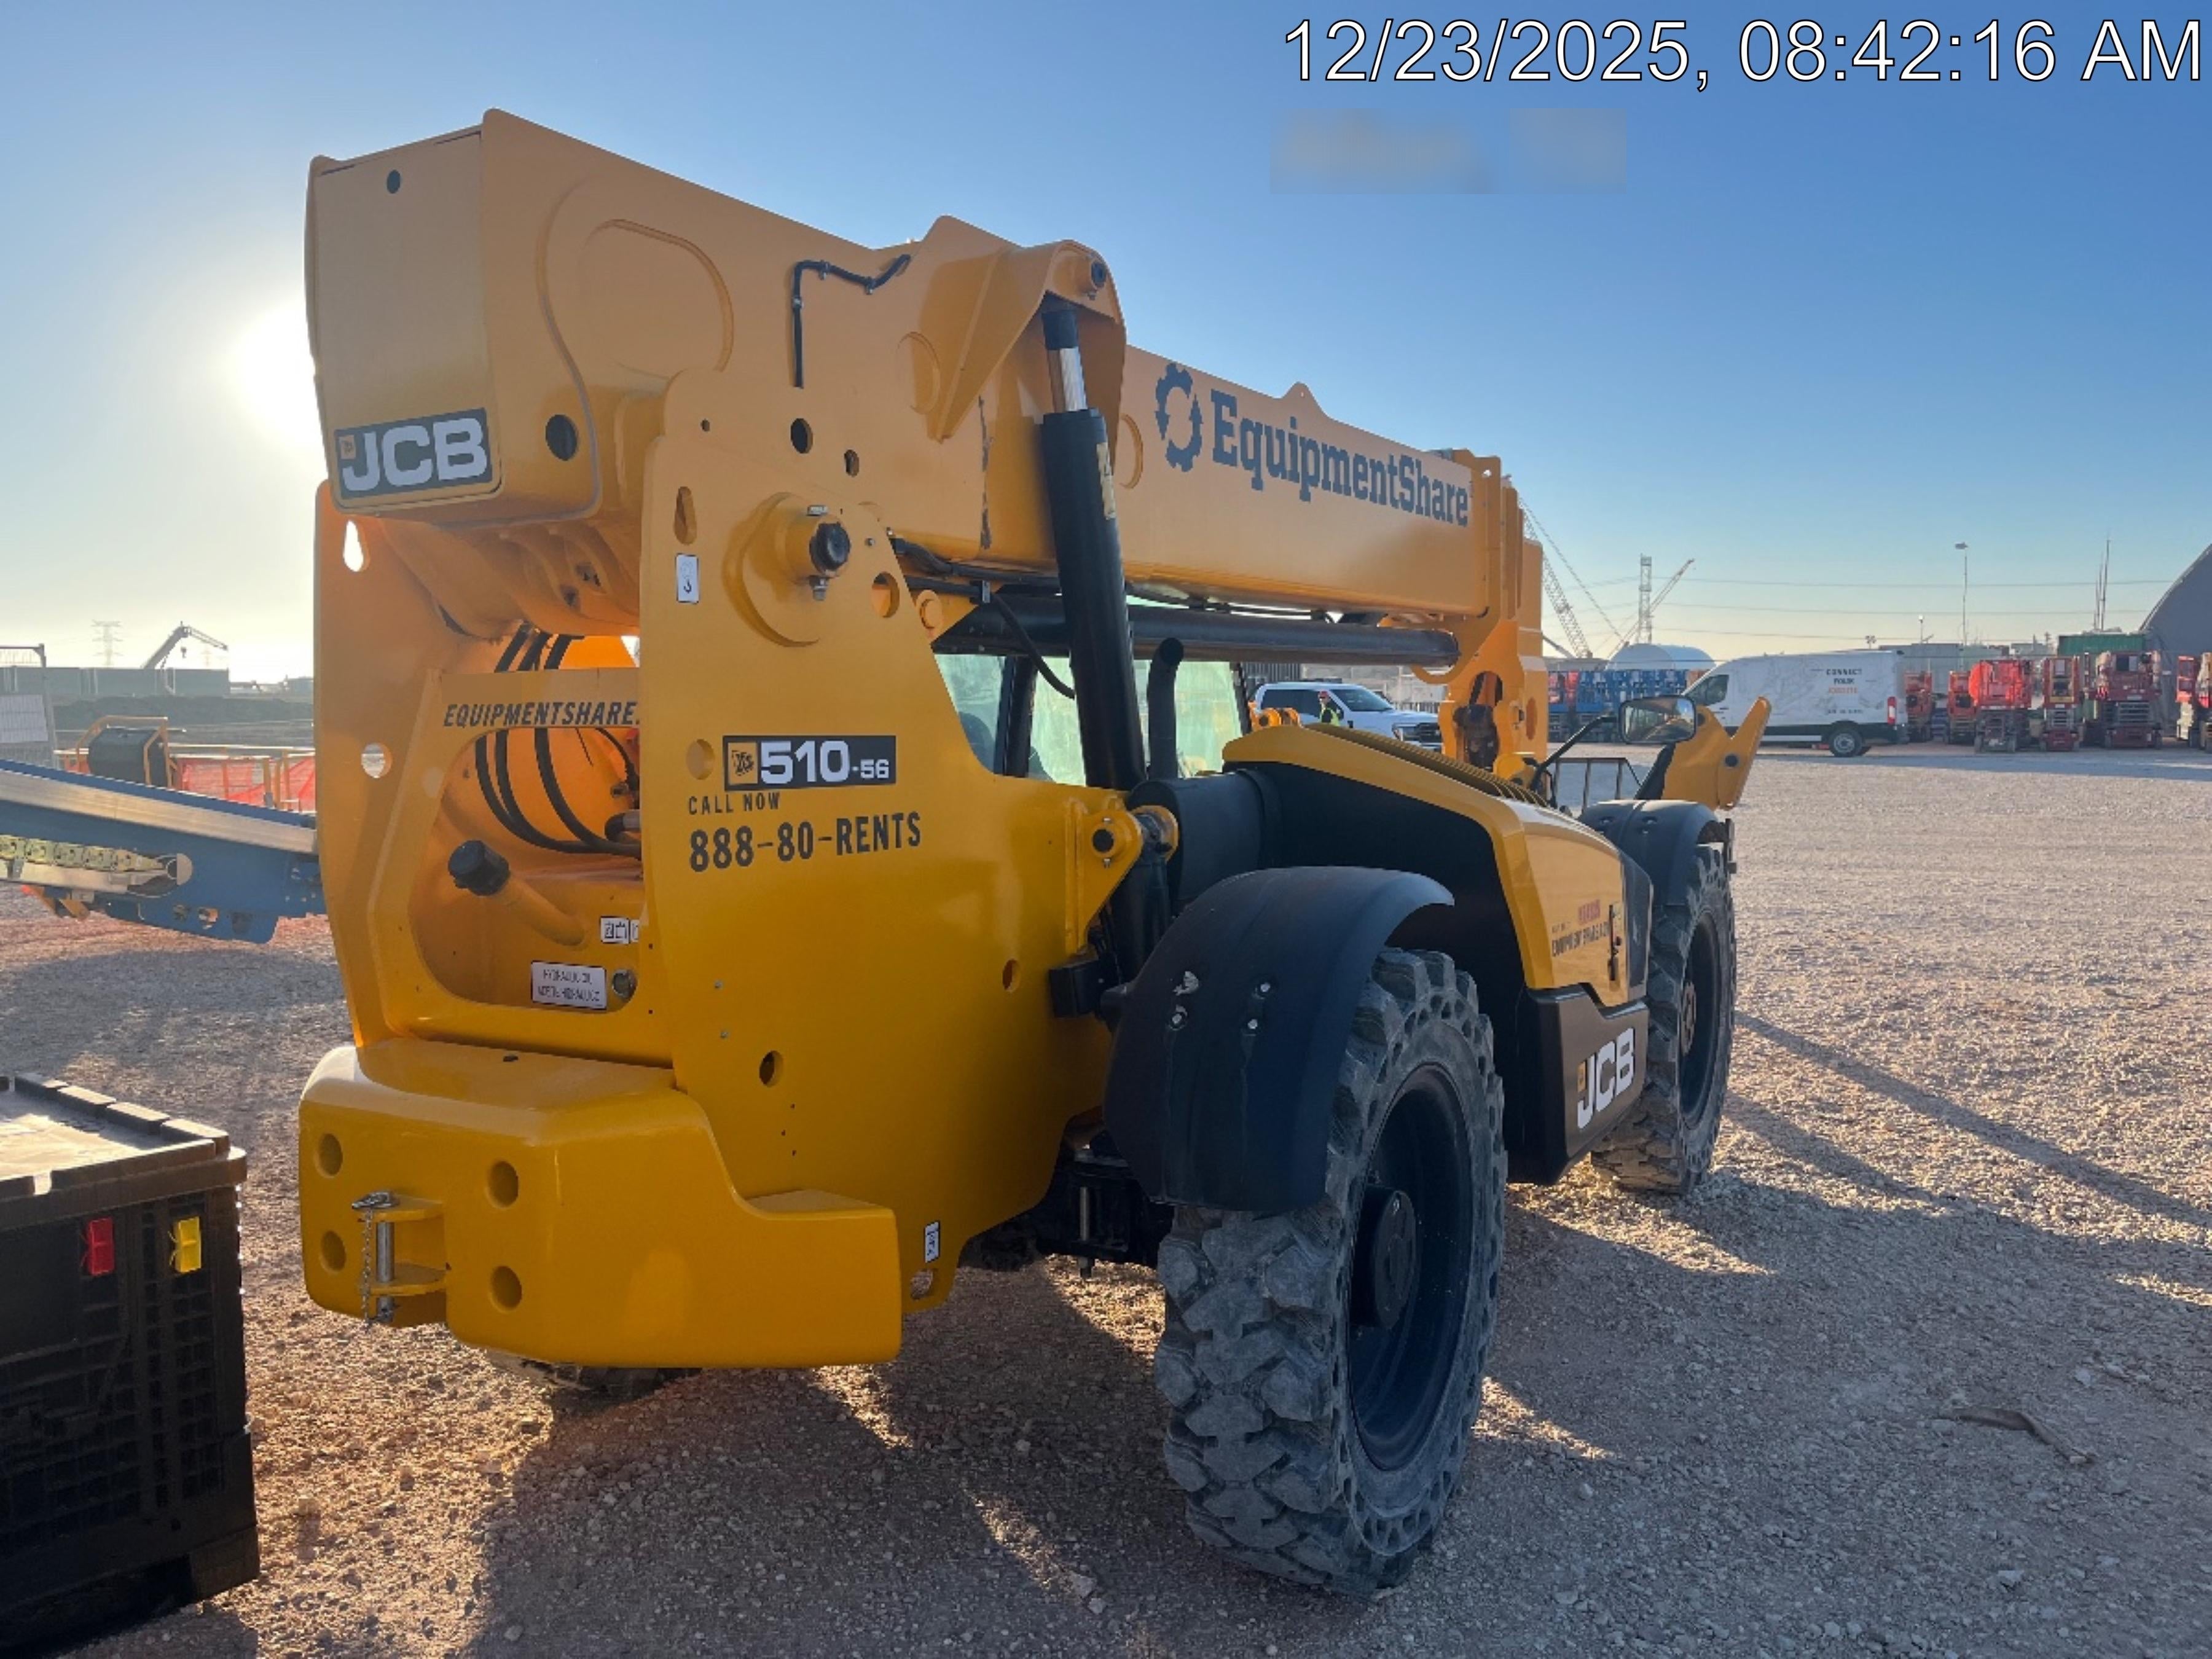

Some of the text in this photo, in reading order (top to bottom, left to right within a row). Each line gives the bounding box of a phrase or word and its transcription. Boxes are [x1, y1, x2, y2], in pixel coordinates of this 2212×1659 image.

[342, 417, 487, 491] JCB
[1210, 388, 1468, 527] EquipmentShare
[760, 739, 890, 785] 510-56
[688, 792, 780, 815] CALL NOW
[689, 812, 922, 873] 888-80-RENTS
[1577, 1027, 1634, 1129] JCB
